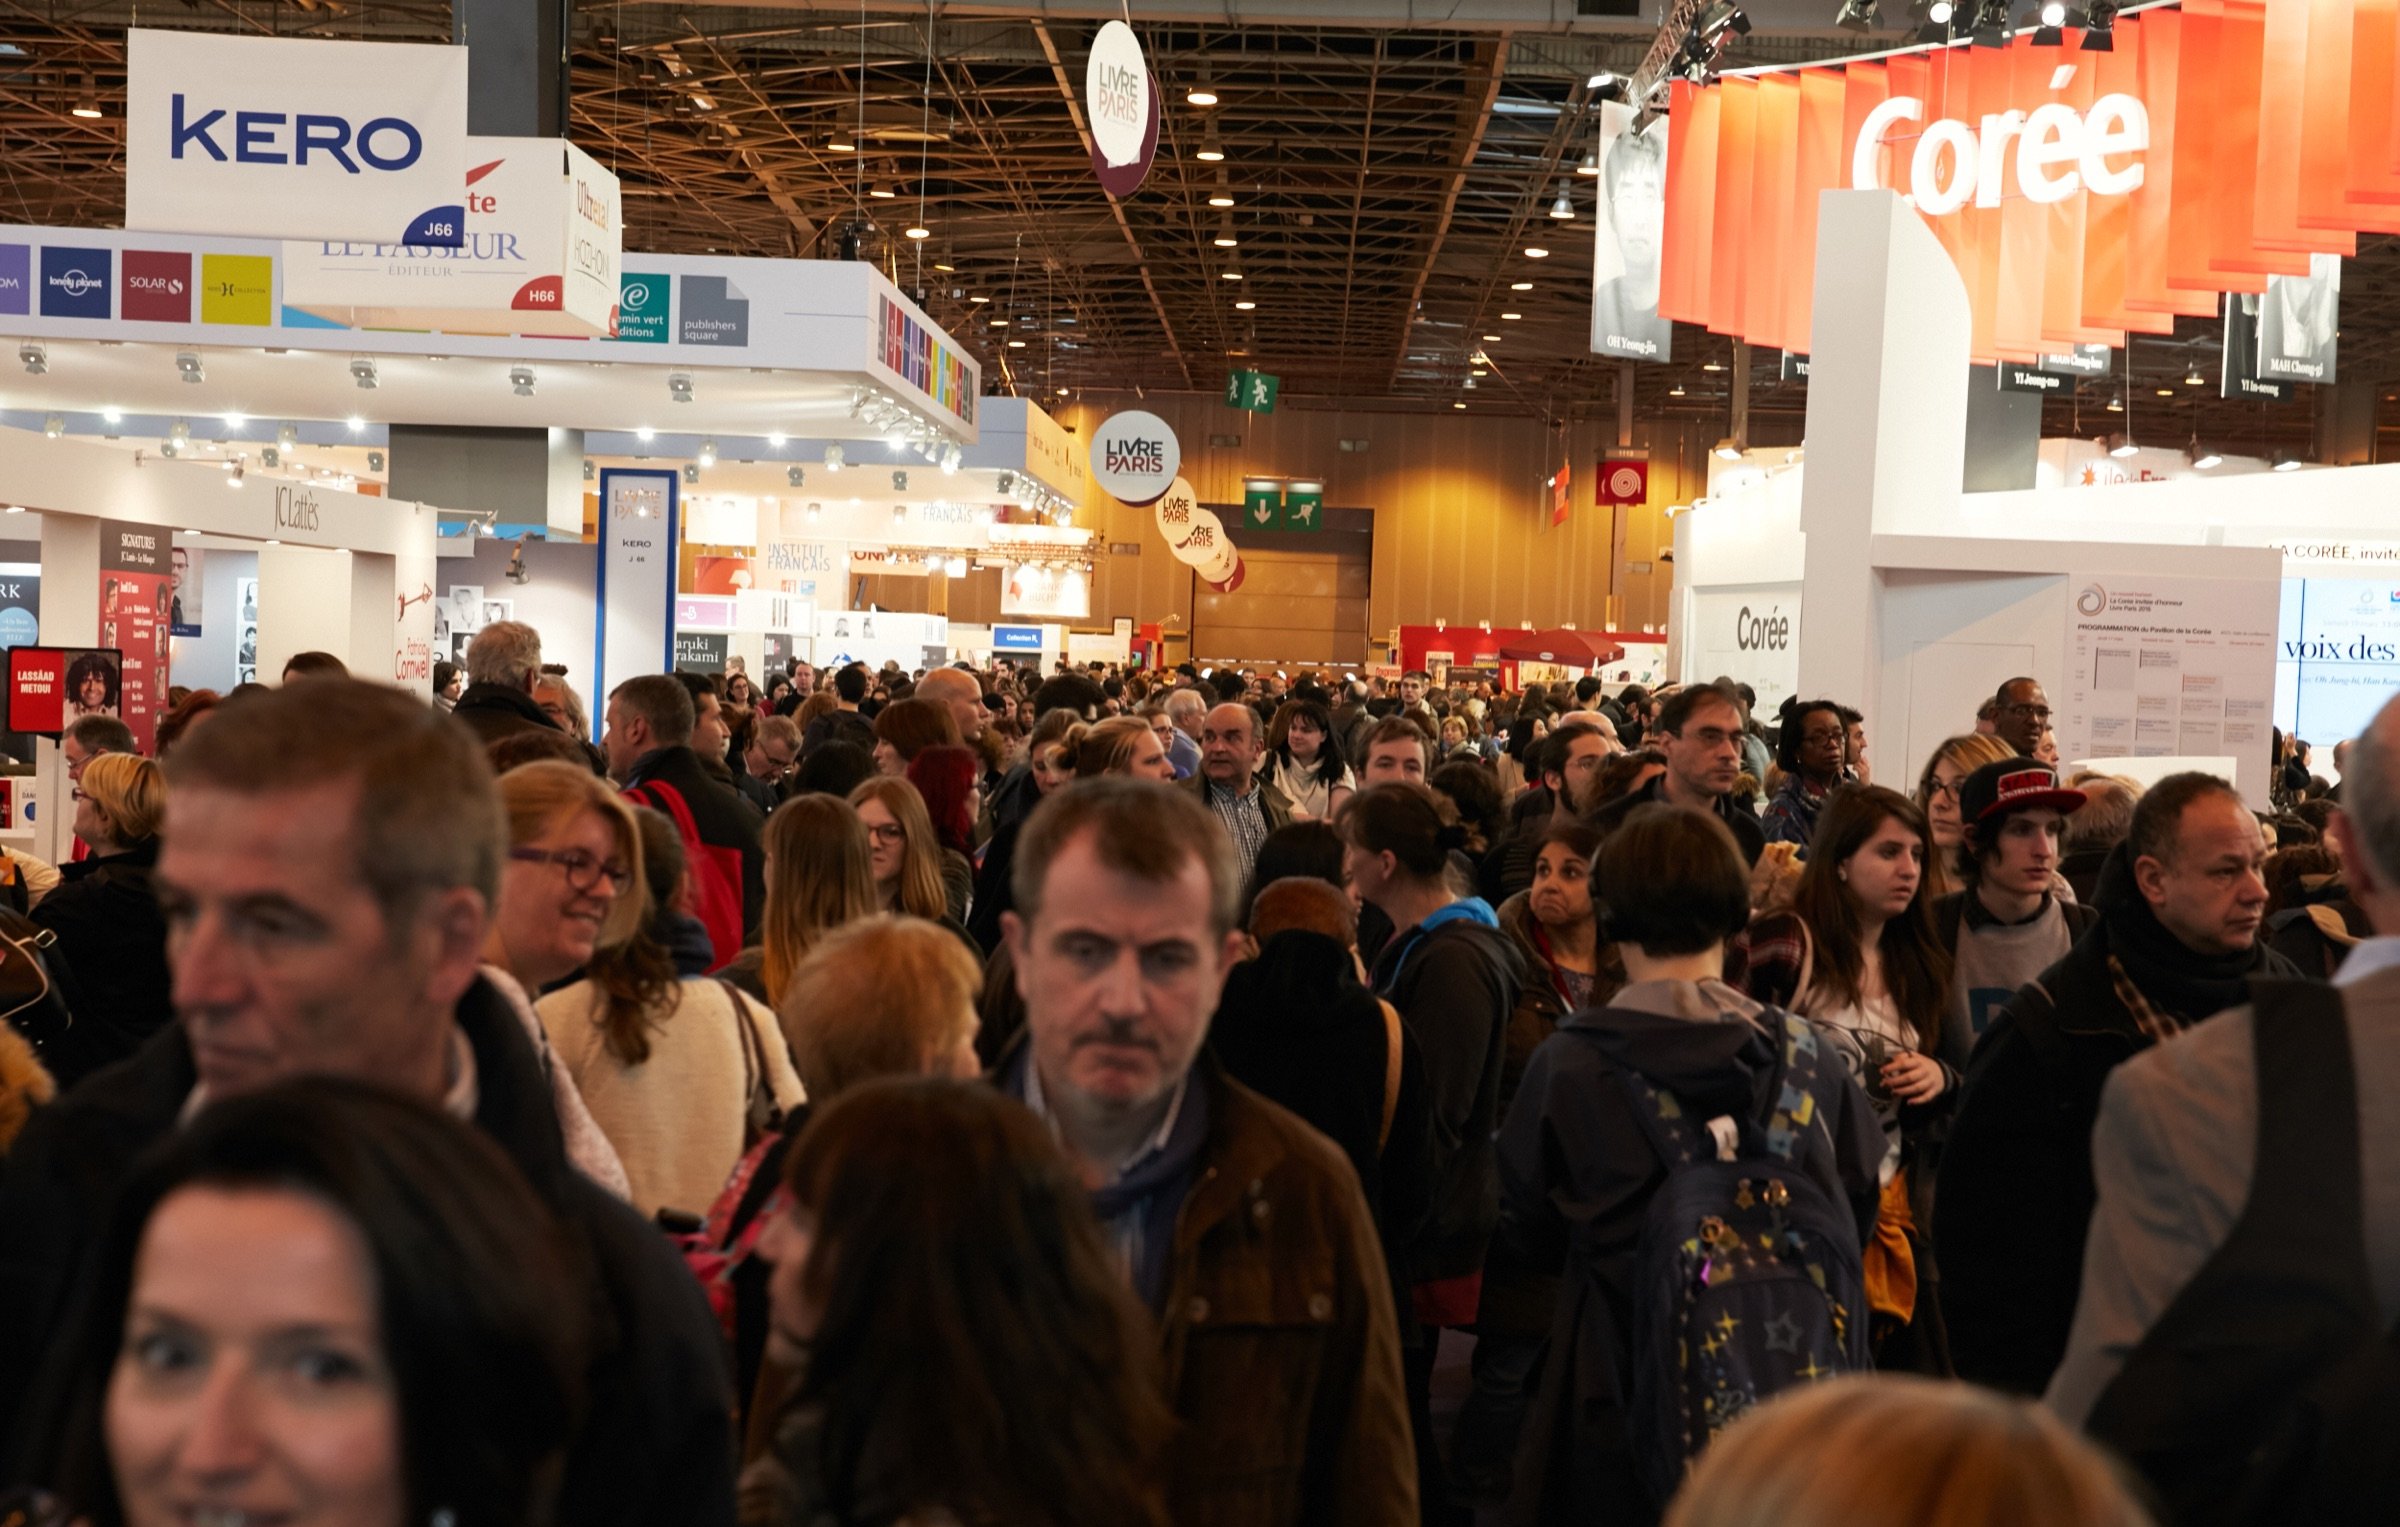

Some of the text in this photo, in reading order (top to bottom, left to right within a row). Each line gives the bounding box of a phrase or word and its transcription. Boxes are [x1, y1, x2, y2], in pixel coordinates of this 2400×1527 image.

[1100, 62, 1138, 99] LIVRE
[1099, 88, 1137, 123] PARIS
[171, 93, 423, 174] KERO
[1853, 64, 2150, 216] Corée
[465, 192, 497, 213] te
[424, 222, 453, 237] J66
[388, 264, 453, 277] ÉDITEUR
[50, 275, 102, 290] lonely planet
[130, 276, 166, 289] SOLAR
[529, 290, 557, 302] H66
[643, 314, 664, 325] vert
[685, 320, 737, 334] publishers
[685, 331, 719, 342] square
[1607, 335, 1657, 355] OH Yeong-jin
[2270, 358, 2324, 378] MAH Chong-gi
[1106, 437, 1163, 457] LIVRE
[1105, 455, 1163, 474] PARIS
[275, 486, 320, 533] JC Lattès
[1163, 496, 1189, 512] LIVRE
[1163, 508, 1190, 524] PARIS
[121, 533, 155, 550] SIGNATURES
[622, 539, 652, 548] KERO
[2294, 542, 2355, 561] CORÉE,
[1738, 605, 1789, 650] Corée
[2078, 624, 2140, 632] PROGRAMMATION
[2285, 633, 2395, 661] voix des
[395, 649, 430, 681] Cornwell
[21, 684, 51, 694] METOUI
